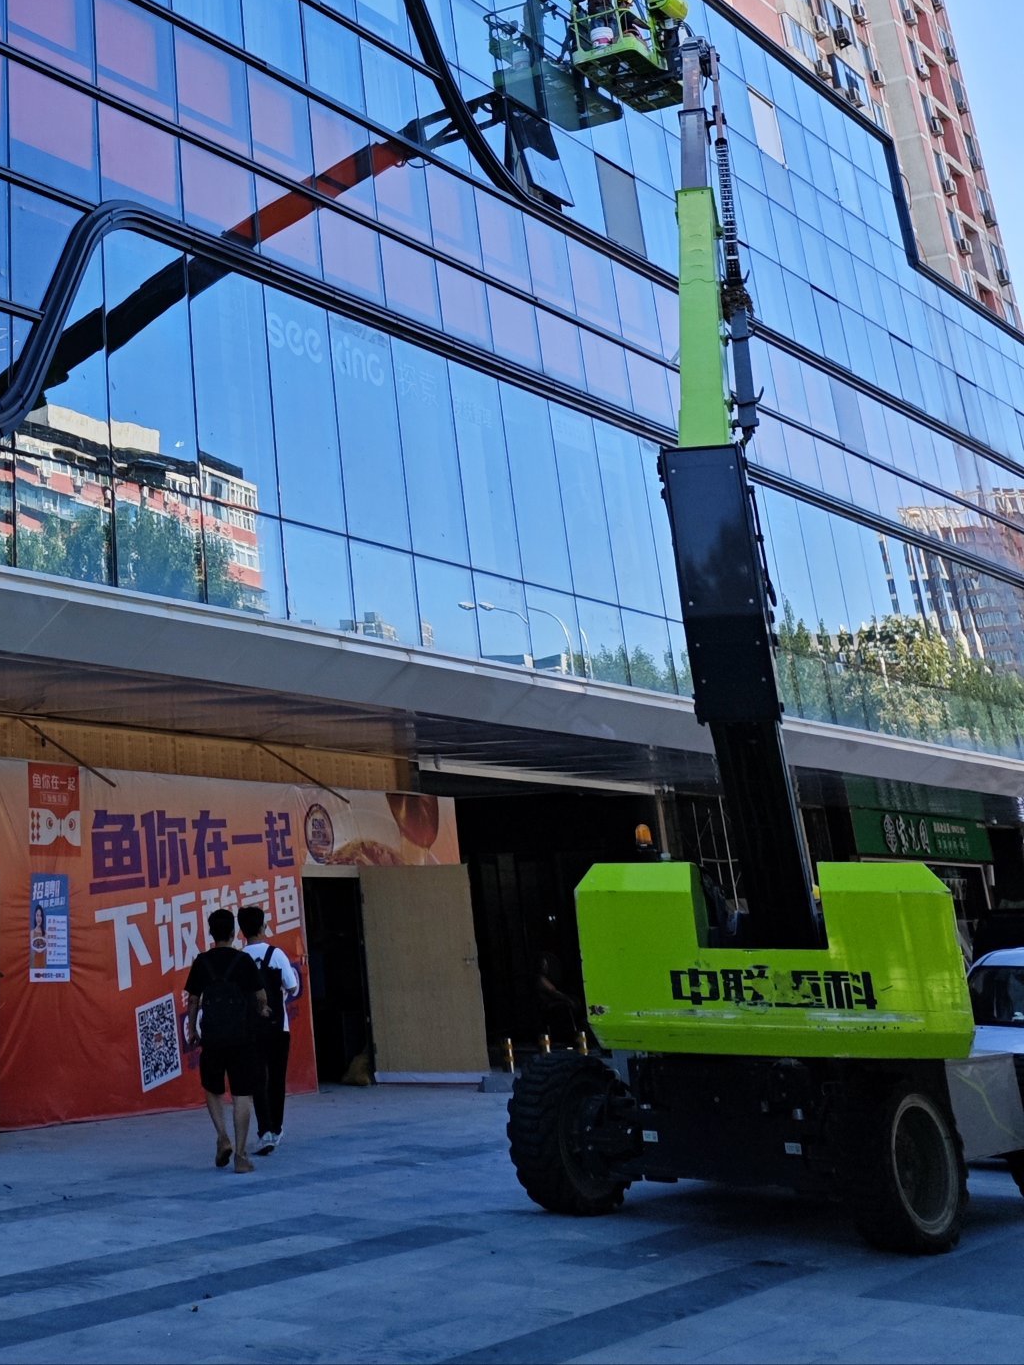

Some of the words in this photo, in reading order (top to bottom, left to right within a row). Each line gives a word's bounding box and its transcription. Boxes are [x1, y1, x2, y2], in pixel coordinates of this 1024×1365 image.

[32, 773, 76, 791] 鱼你在一起
[90, 809, 294, 894] 鱼你在一起
